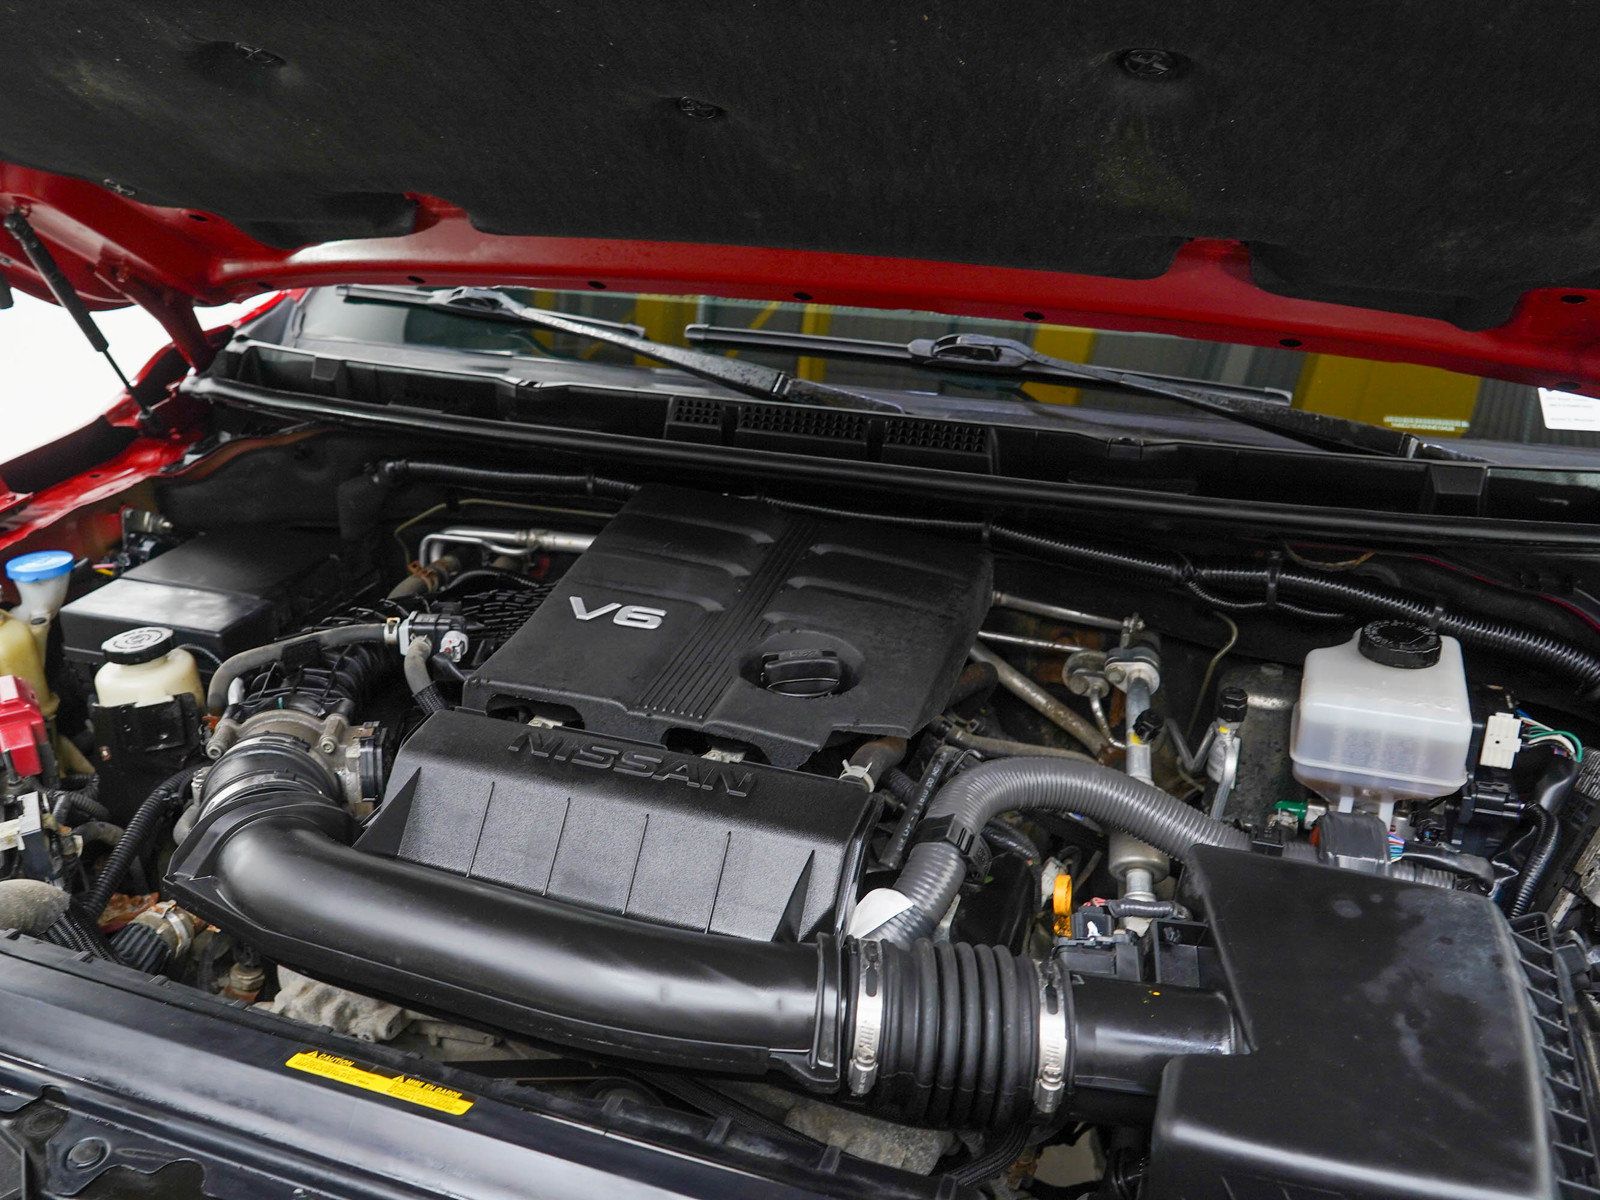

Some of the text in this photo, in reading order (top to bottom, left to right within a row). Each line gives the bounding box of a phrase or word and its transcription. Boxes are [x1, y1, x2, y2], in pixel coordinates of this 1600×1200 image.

[569, 595, 667, 629] V6
[507, 732, 753, 797] NISSAN
[317, 1053, 355, 1067] CAUTION
